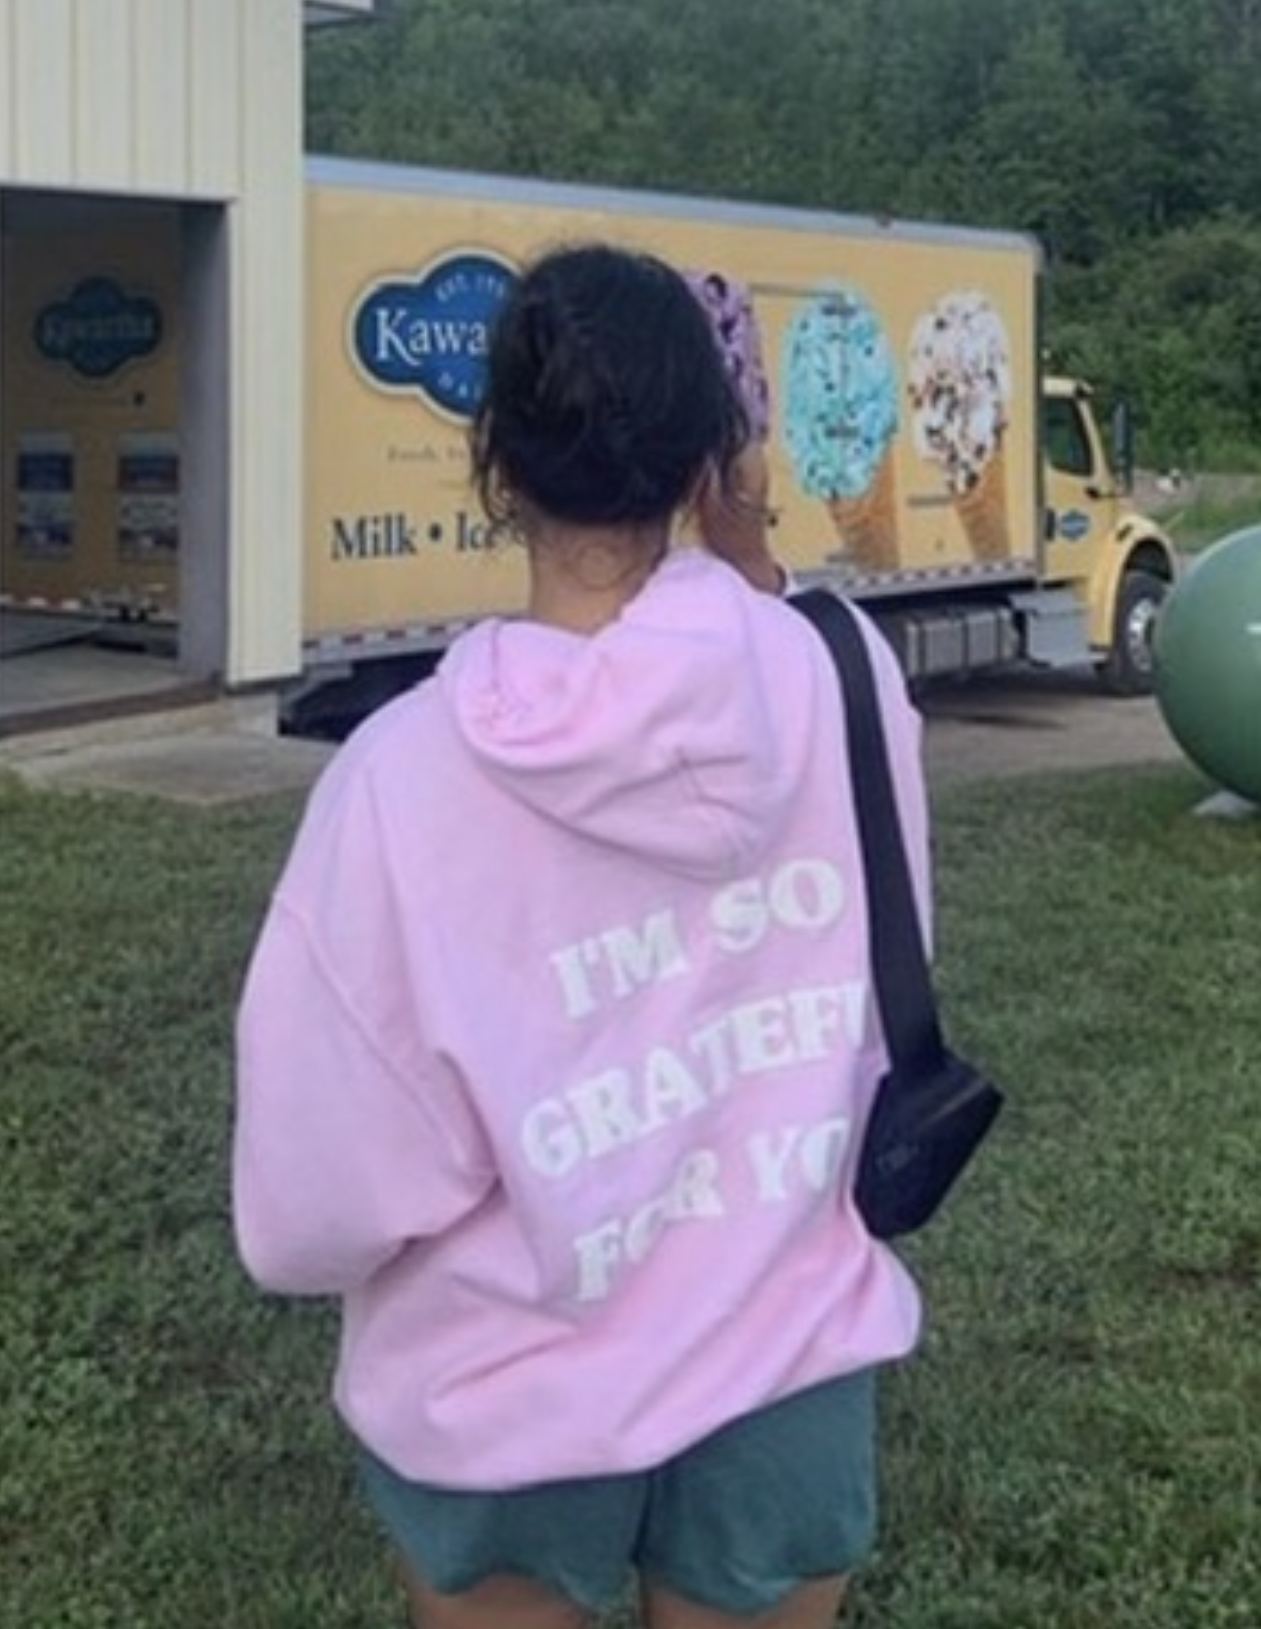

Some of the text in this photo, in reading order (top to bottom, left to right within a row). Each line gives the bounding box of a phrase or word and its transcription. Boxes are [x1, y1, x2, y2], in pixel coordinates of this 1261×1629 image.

[331, 513, 418, 561] Milk
[549, 858, 844, 1018] I'M SO
